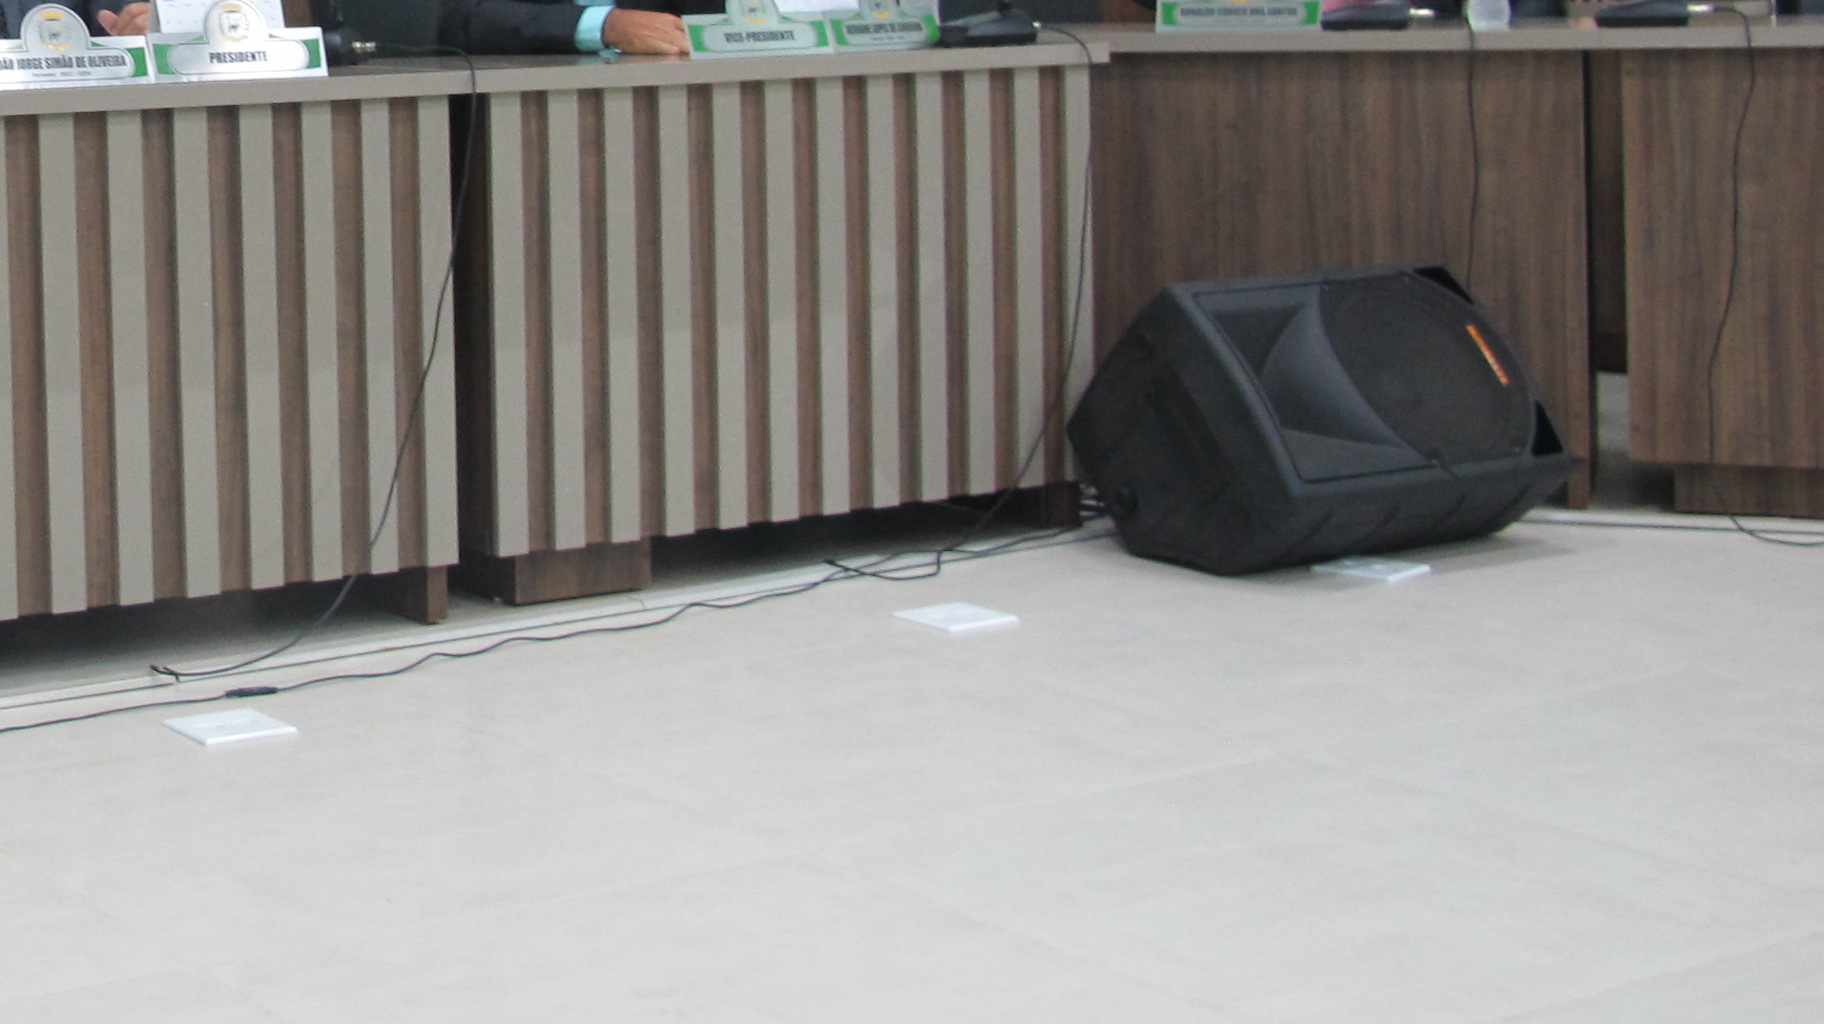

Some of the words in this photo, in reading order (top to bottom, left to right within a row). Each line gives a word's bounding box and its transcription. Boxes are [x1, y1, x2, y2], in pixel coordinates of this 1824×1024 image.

[723, 30, 795, 43] VICE-PRESIDENTE
[16, 57, 44, 70] JORGE
[45, 54, 74, 69] SIMÃO
[75, 56, 87, 68] DE
[87, 55, 127, 68] OLIVEIRA
[209, 50, 267, 64] PRESIDENTE
